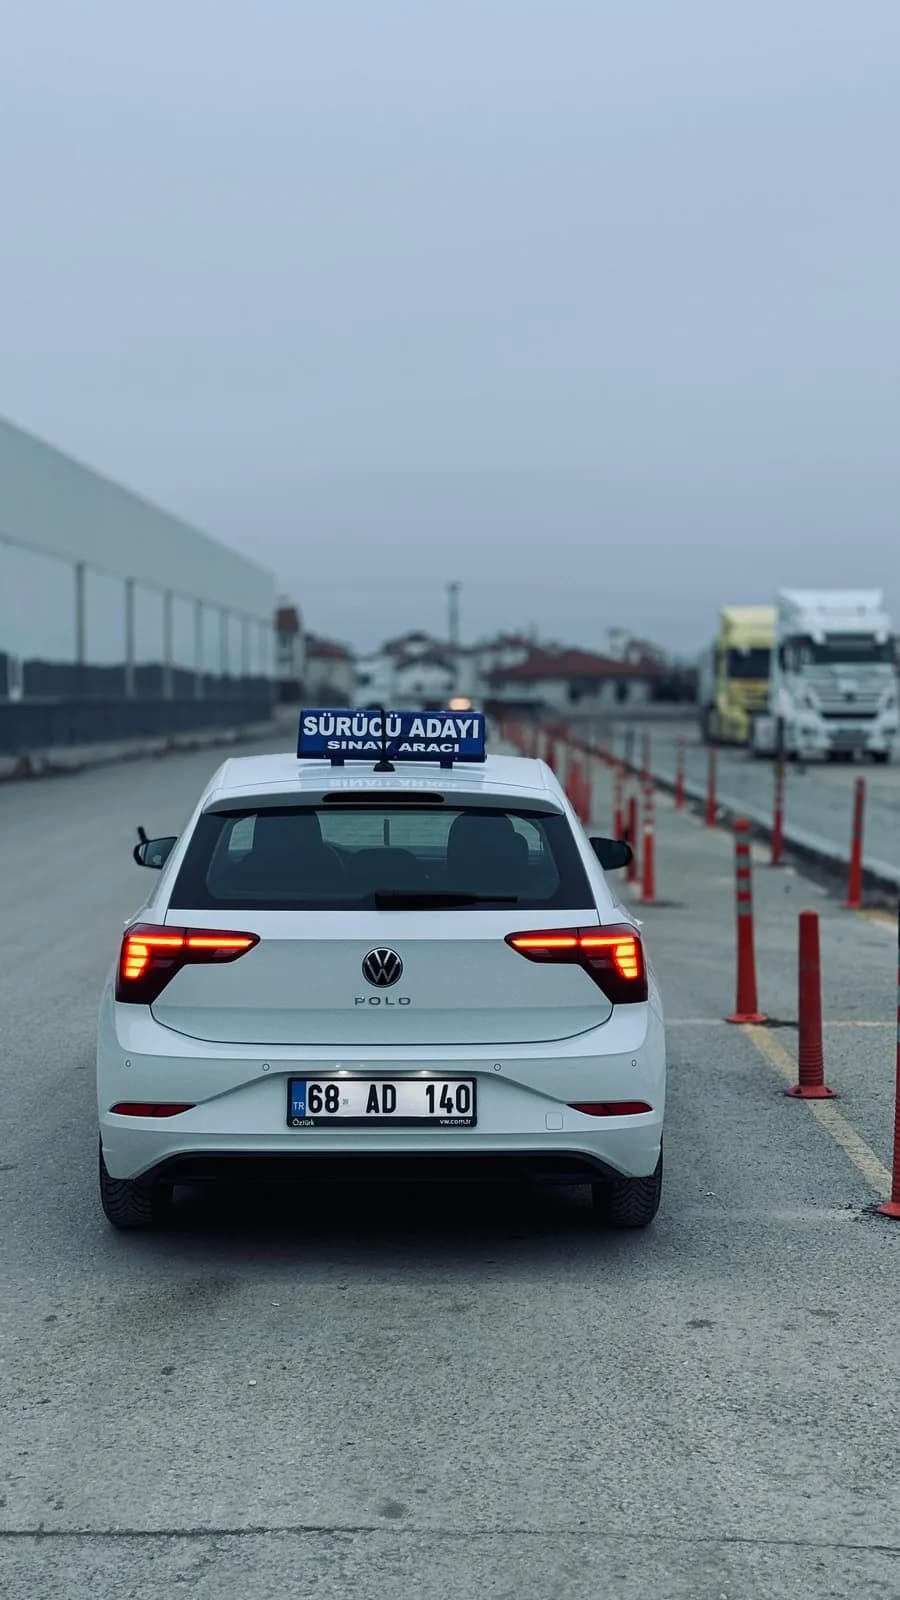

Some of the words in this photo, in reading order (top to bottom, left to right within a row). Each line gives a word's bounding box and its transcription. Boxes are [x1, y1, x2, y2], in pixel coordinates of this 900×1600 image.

[303, 712, 402, 738] SÜRÜCÜ
[408, 718, 479, 739] ADAYI
[327, 740, 392, 751] SINAV
[398, 743, 460, 753] ARACI
[354, 996, 411, 1006] POLO
[308, 1084, 340, 1114] 68
[366, 1084, 397, 1114] AD
[425, 1084, 471, 1114] 140
[292, 1101, 305, 1111] TR
